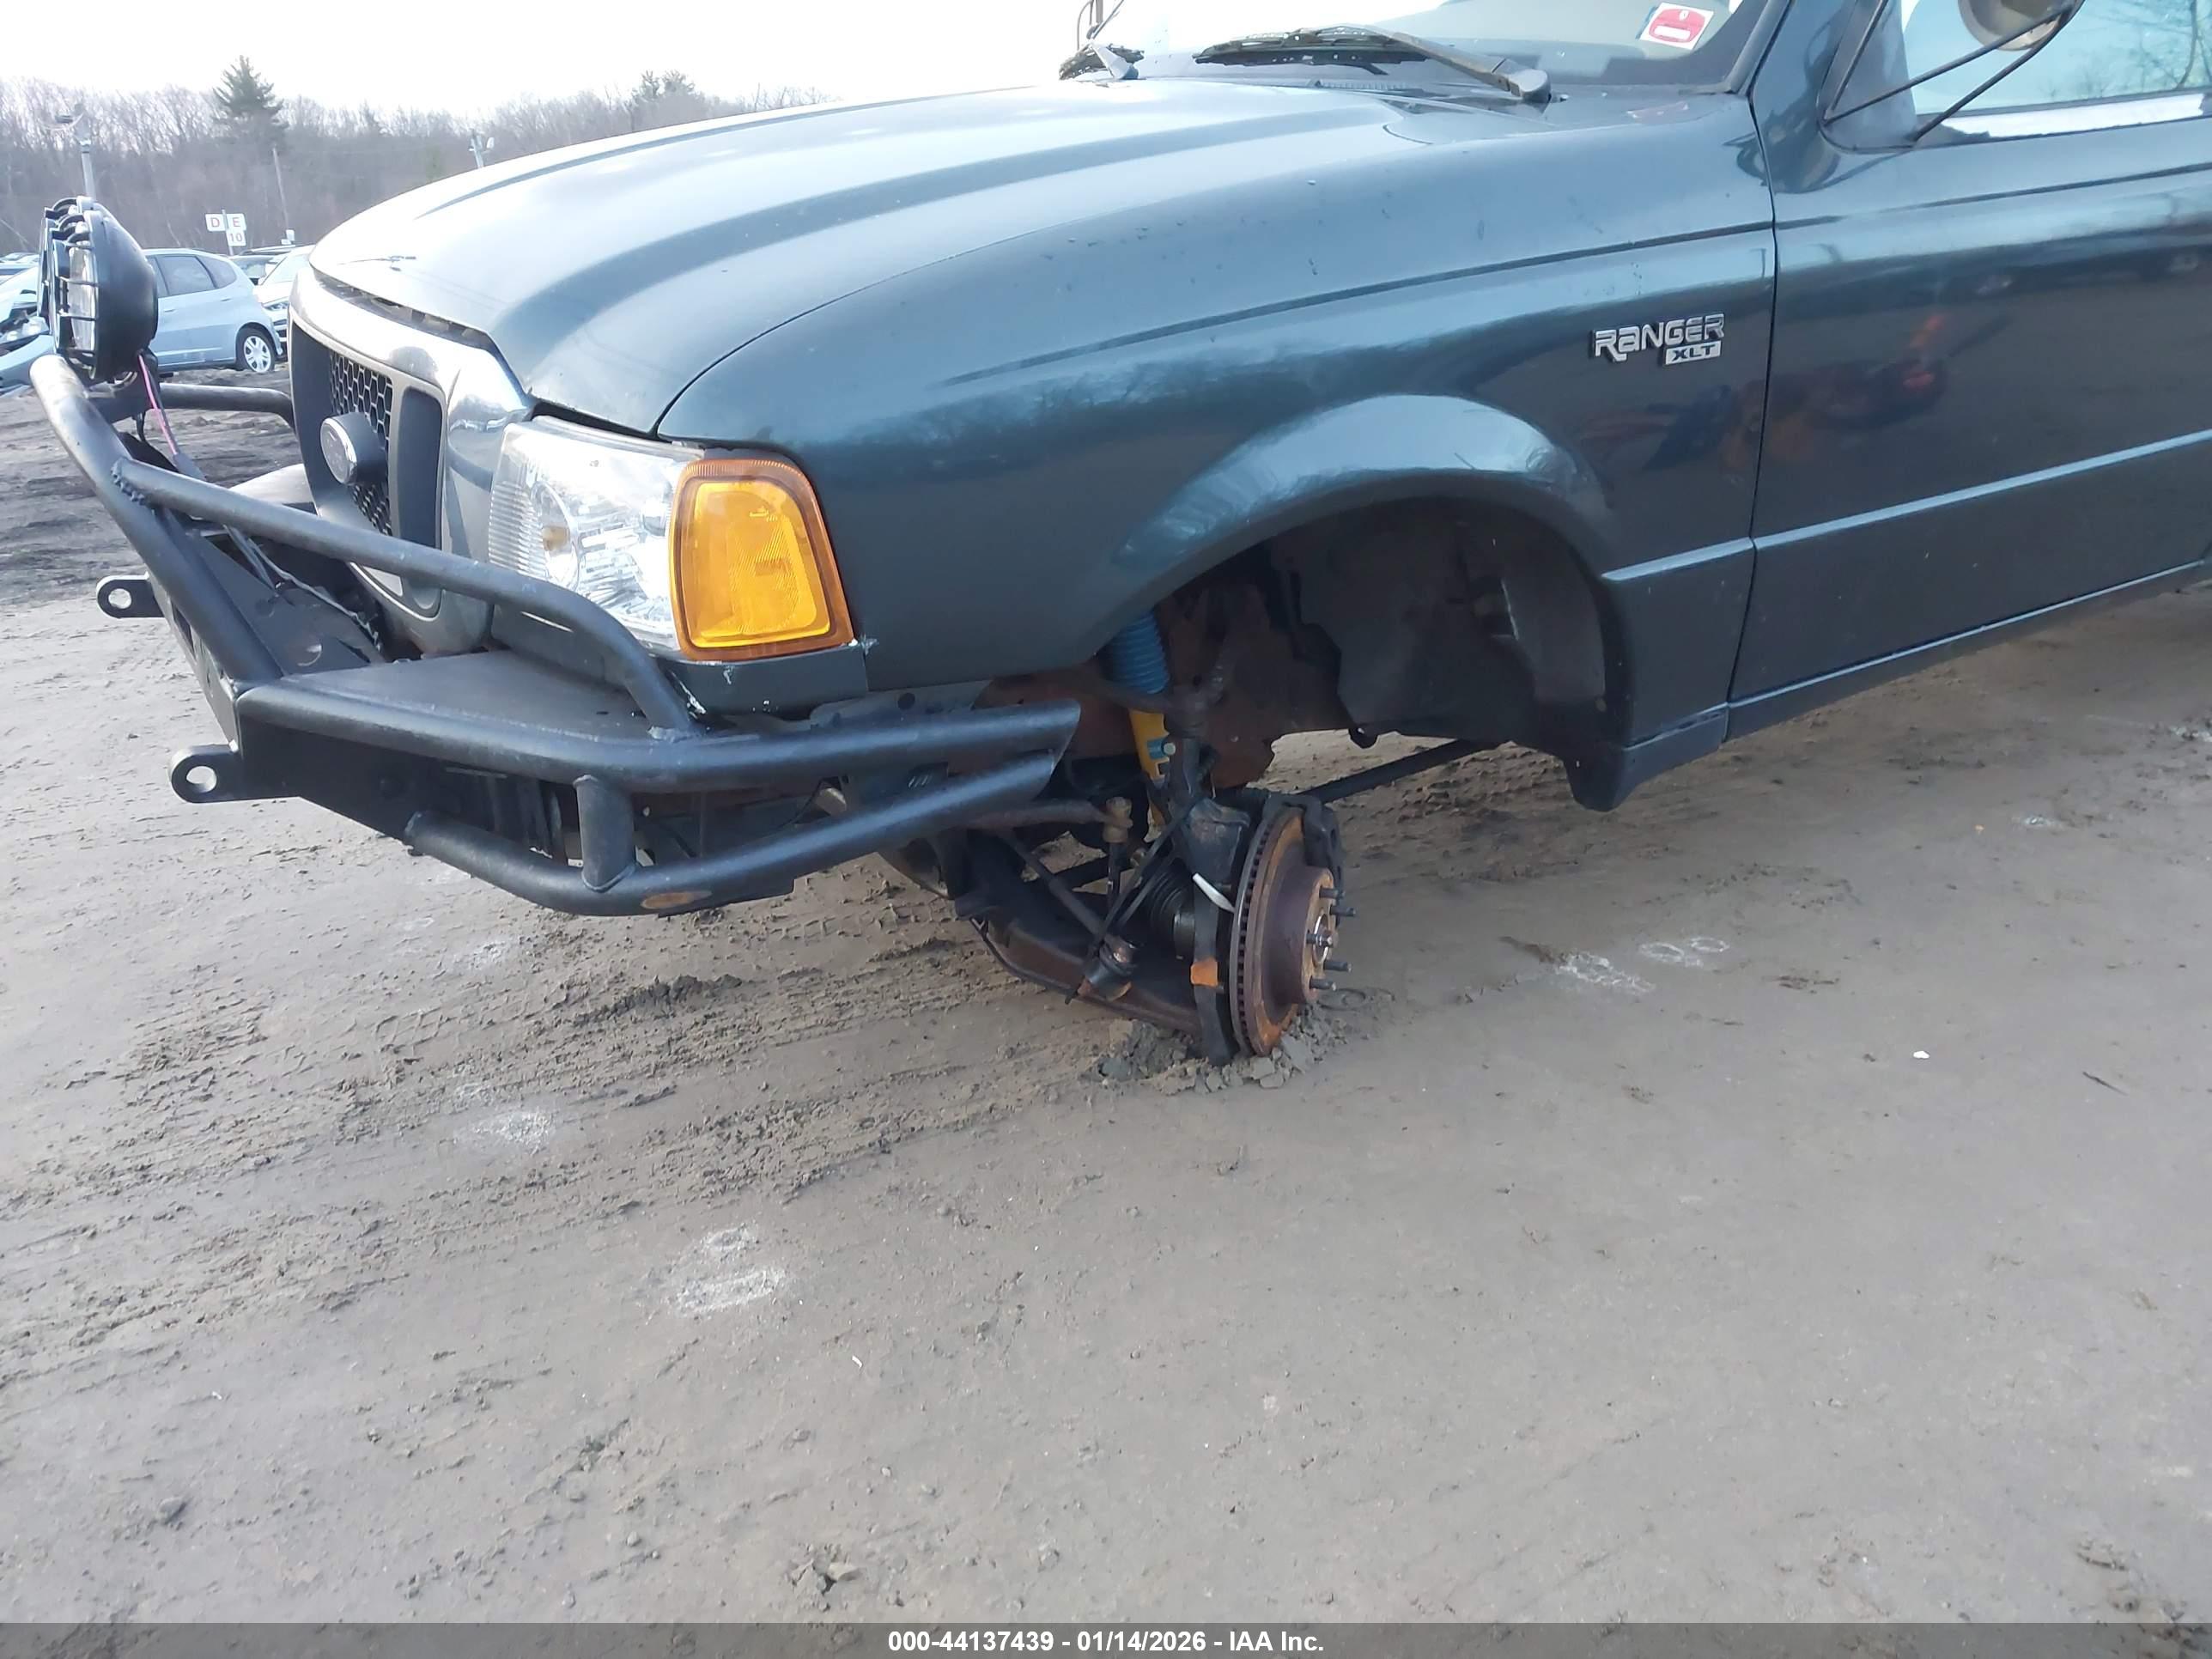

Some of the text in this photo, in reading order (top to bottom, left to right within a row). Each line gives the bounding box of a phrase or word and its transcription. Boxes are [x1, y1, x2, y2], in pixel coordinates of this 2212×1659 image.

[210, 217, 220, 228] D
[232, 216, 241, 228] E
[229, 233, 243, 242] 10
[1595, 313, 1725, 362] RANGER
[1670, 343, 1717, 363] XLT
